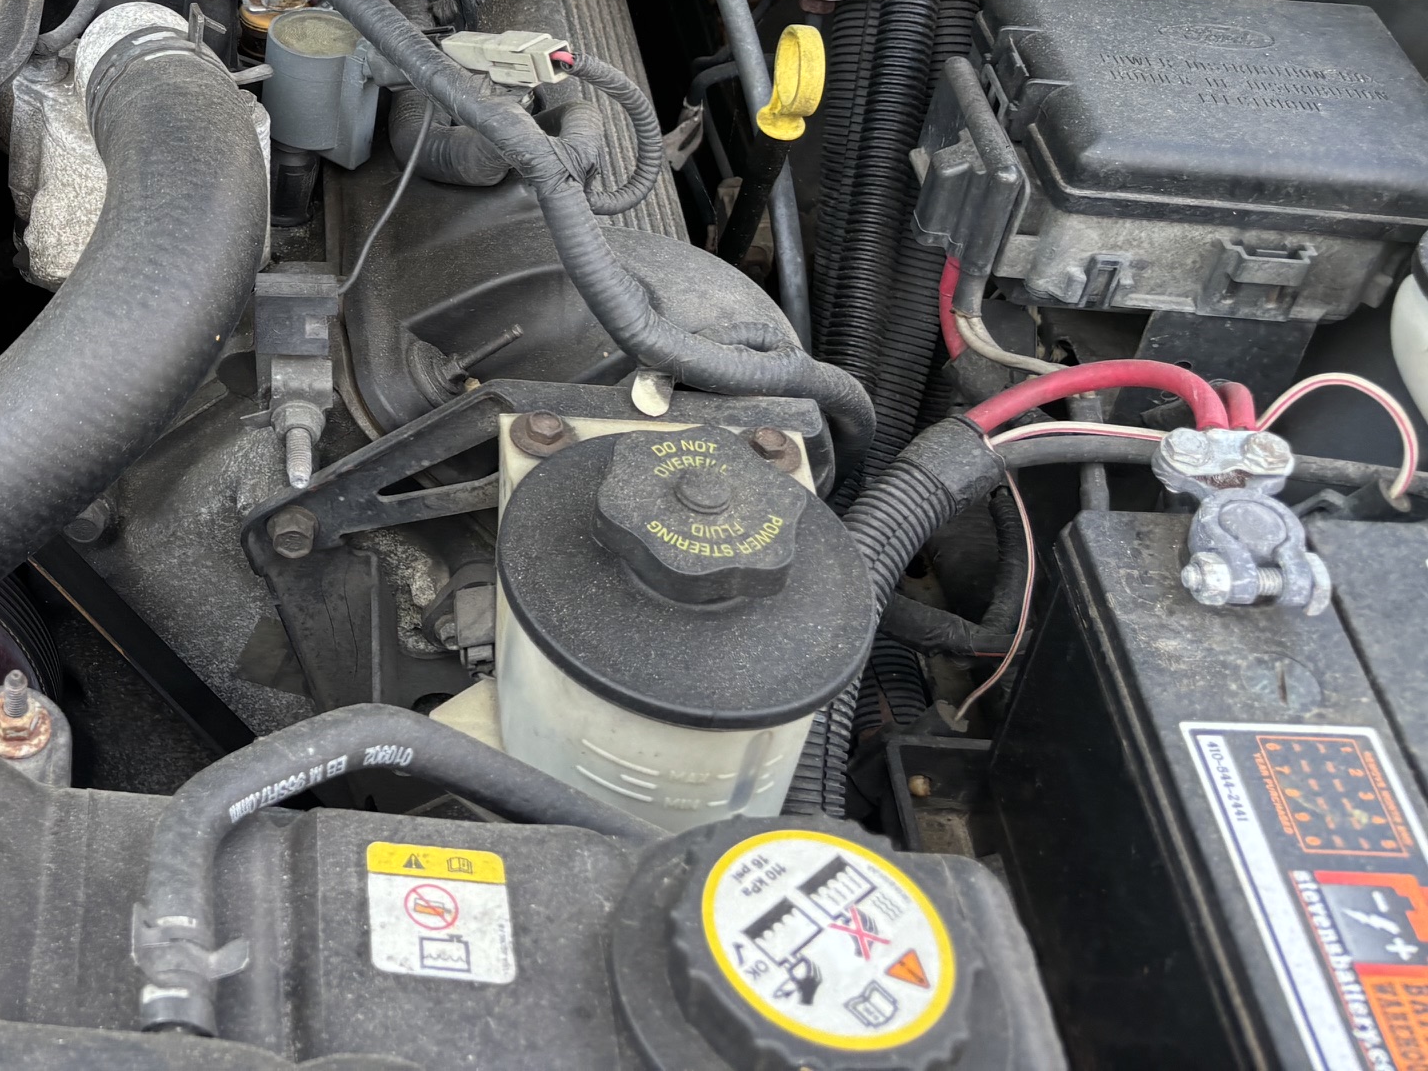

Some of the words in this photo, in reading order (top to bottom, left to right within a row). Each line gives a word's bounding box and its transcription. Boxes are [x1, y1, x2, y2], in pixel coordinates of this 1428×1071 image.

[651, 441, 677, 457] DO
[680, 440, 718, 454] NOT
[646, 520, 735, 558] STEERING
[691, 522, 745, 539] FLUID
[736, 514, 784, 555] POWER
[1206, 740, 1249, 823] 410-844-2441
[751, 854, 770, 870] 16
[765, 862, 788, 881] 110
[731, 863, 752, 884] psi
[740, 878, 770, 897] kPa
[743, 958, 770, 980] OK
